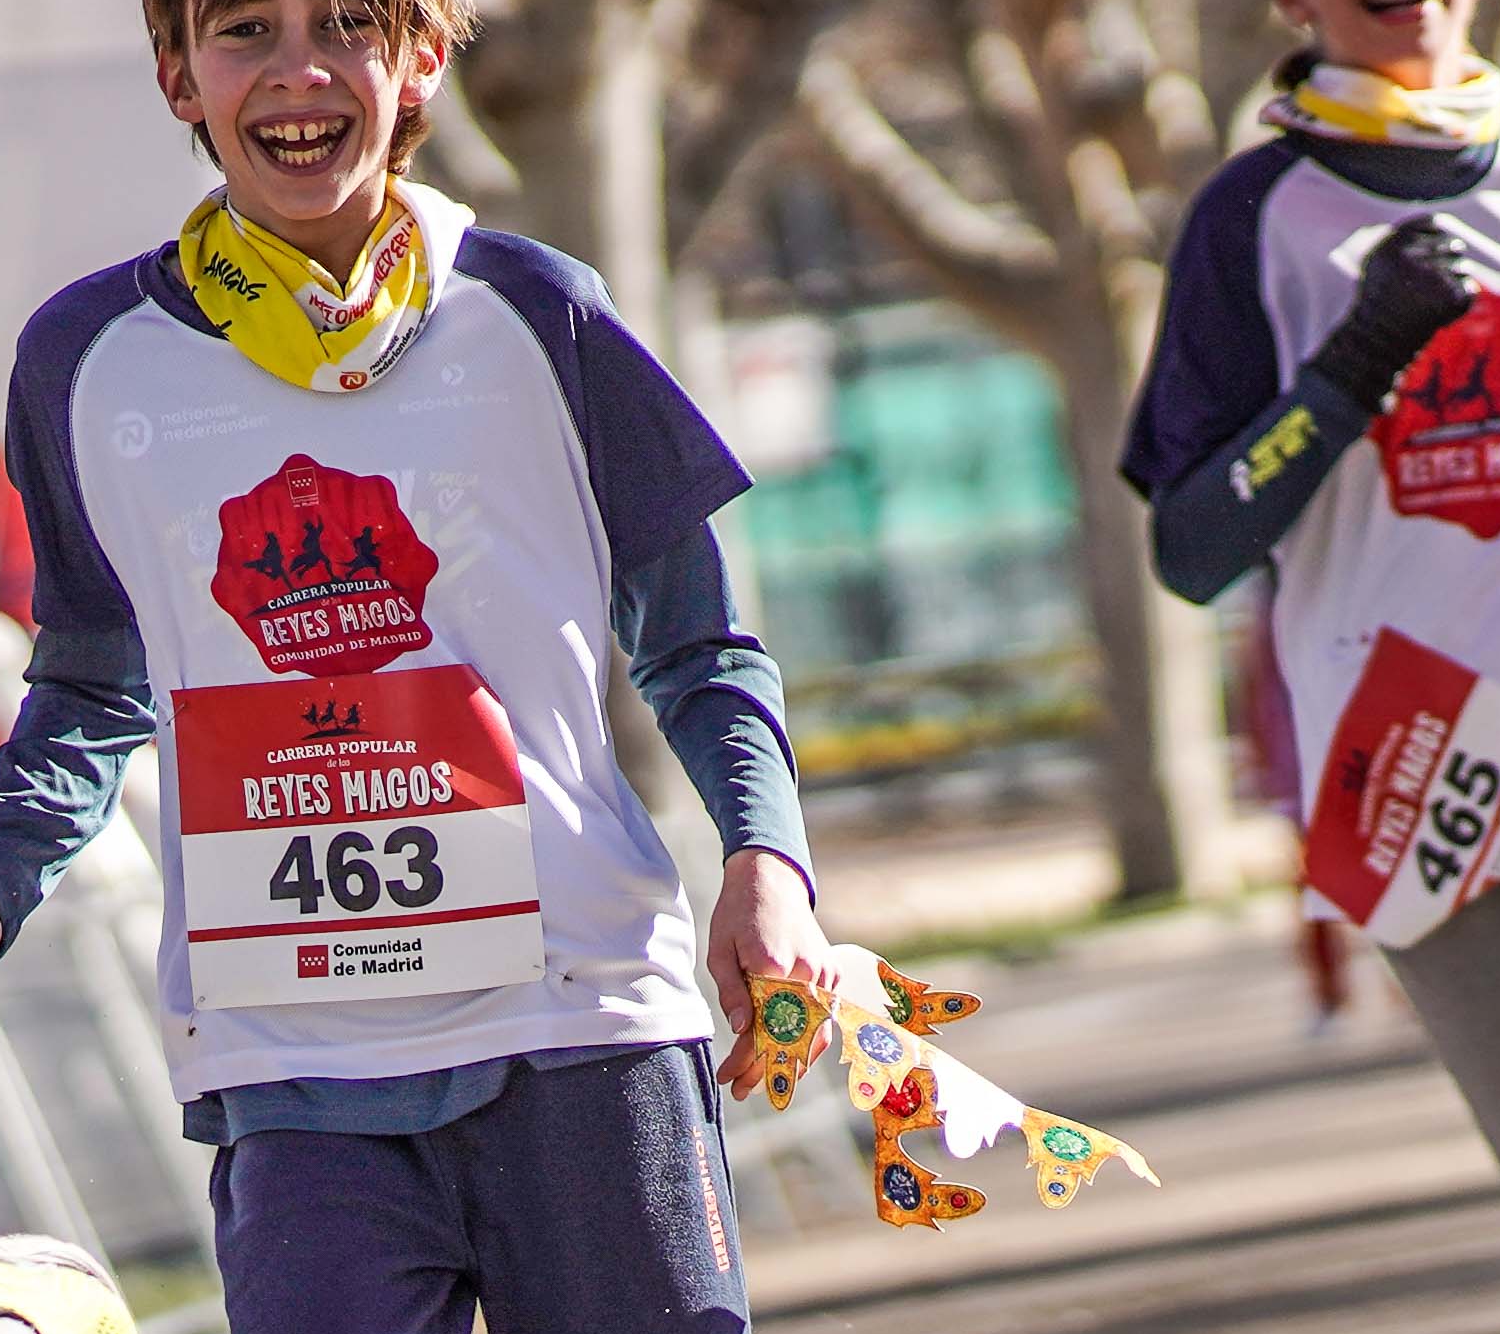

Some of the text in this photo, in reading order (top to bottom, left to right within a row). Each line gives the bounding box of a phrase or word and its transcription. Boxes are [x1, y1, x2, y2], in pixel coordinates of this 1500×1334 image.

[372, 326, 415, 378] nederlanden
[267, 578, 393, 611] CARRERA POPULAR
[258, 596, 416, 647] REYES MAGOS
[270, 631, 422, 666] COMUNIDAD DE MADRID
[267, 740, 417, 765] CARRERA POPULAR
[326, 758, 337, 768] de
[1389, 710, 1448, 798] MAGOS
[242, 760, 453, 820] REYES MAGOS
[1416, 749, 1500, 895] 465
[269, 825, 445, 916] 463
[333, 938, 422, 958] Comunidad
[333, 955, 424, 977] de Madrid
